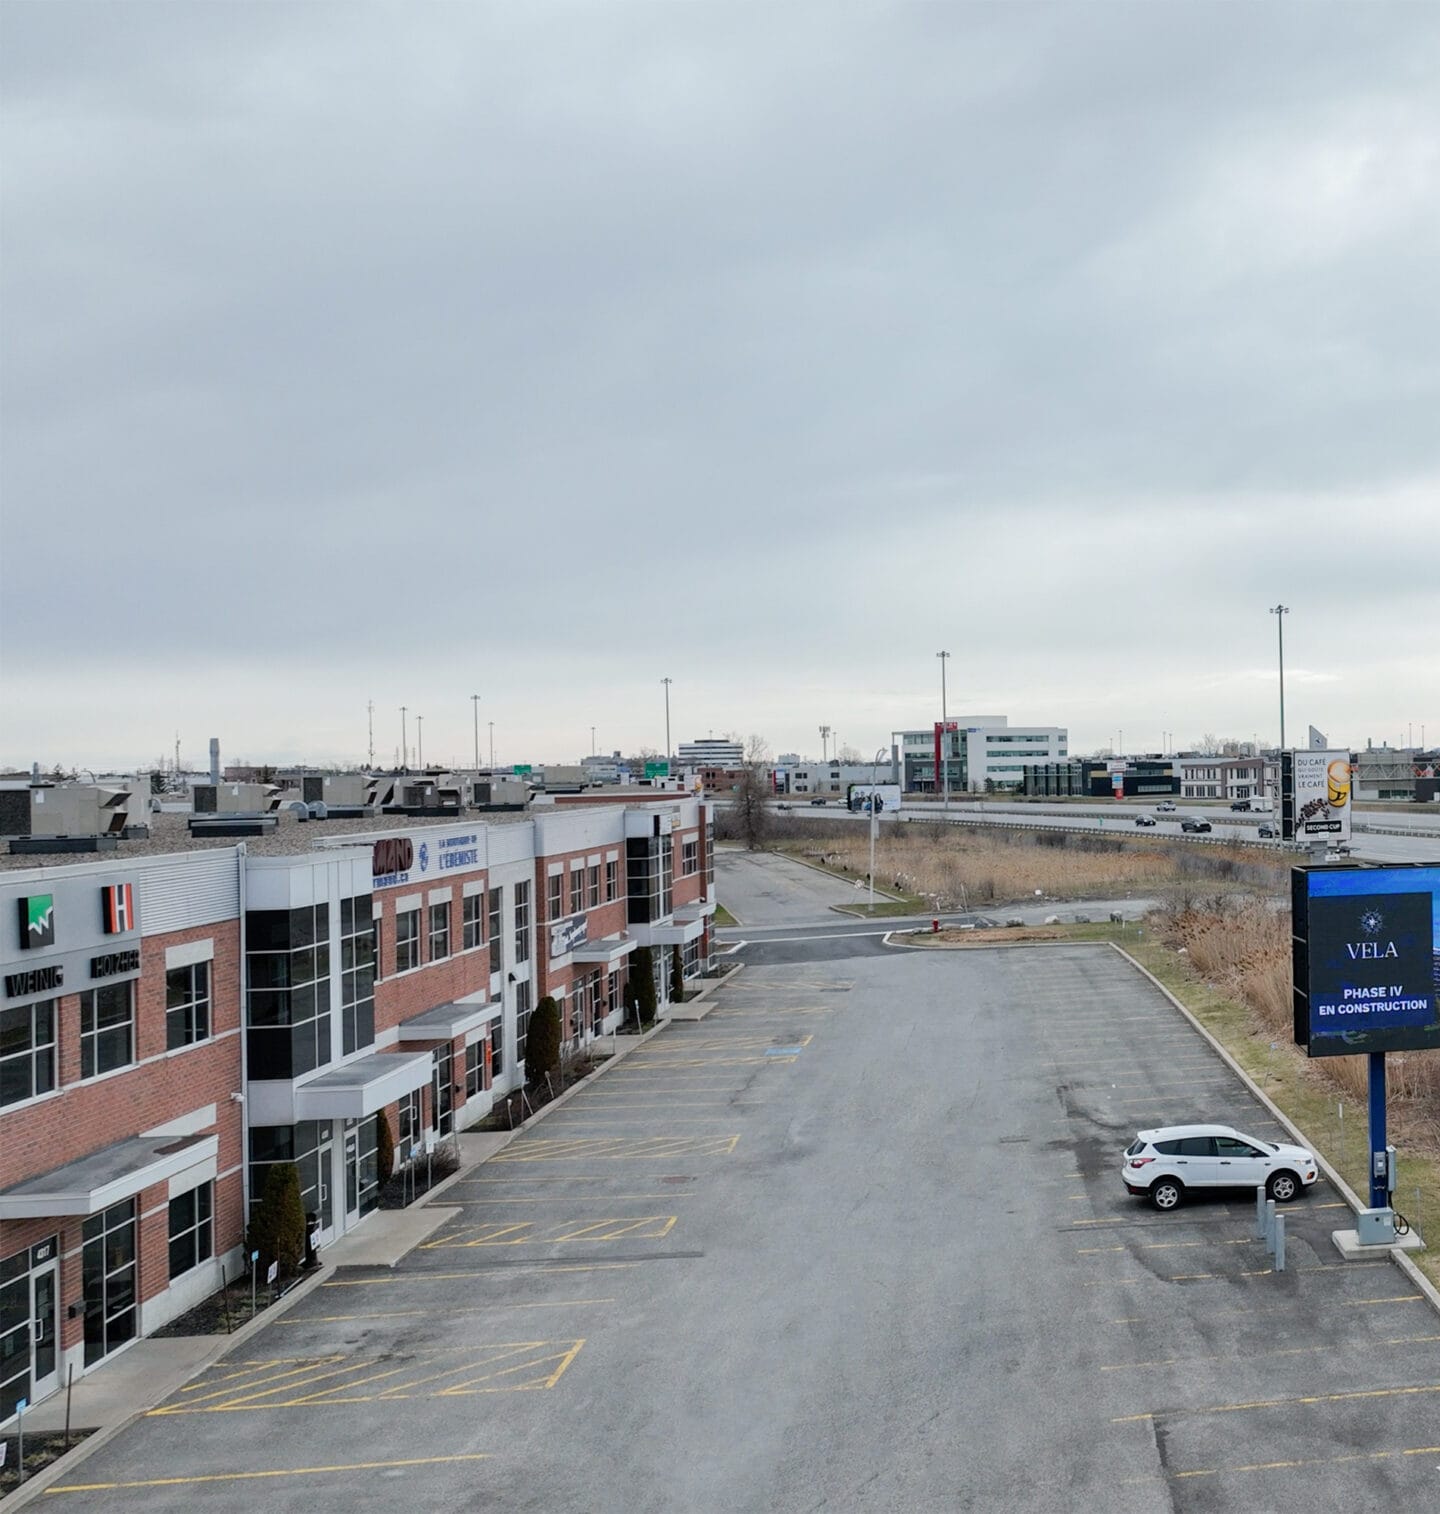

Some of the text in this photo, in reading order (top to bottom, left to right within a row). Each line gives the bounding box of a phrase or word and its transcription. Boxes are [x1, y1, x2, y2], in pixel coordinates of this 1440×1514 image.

[1298, 757, 1326, 767] DU CAFÉ
[1307, 779, 1325, 788] CAFÉ
[1307, 824, 1328, 832] SECOND
[1346, 941, 1399, 960] VELA
[92, 949, 140, 978] HOLZHER
[6, 965, 64, 997] WEINIG
[1343, 985, 1404, 1000] PHASE IV
[1318, 999, 1428, 1016] EN CONSTRUCTION
